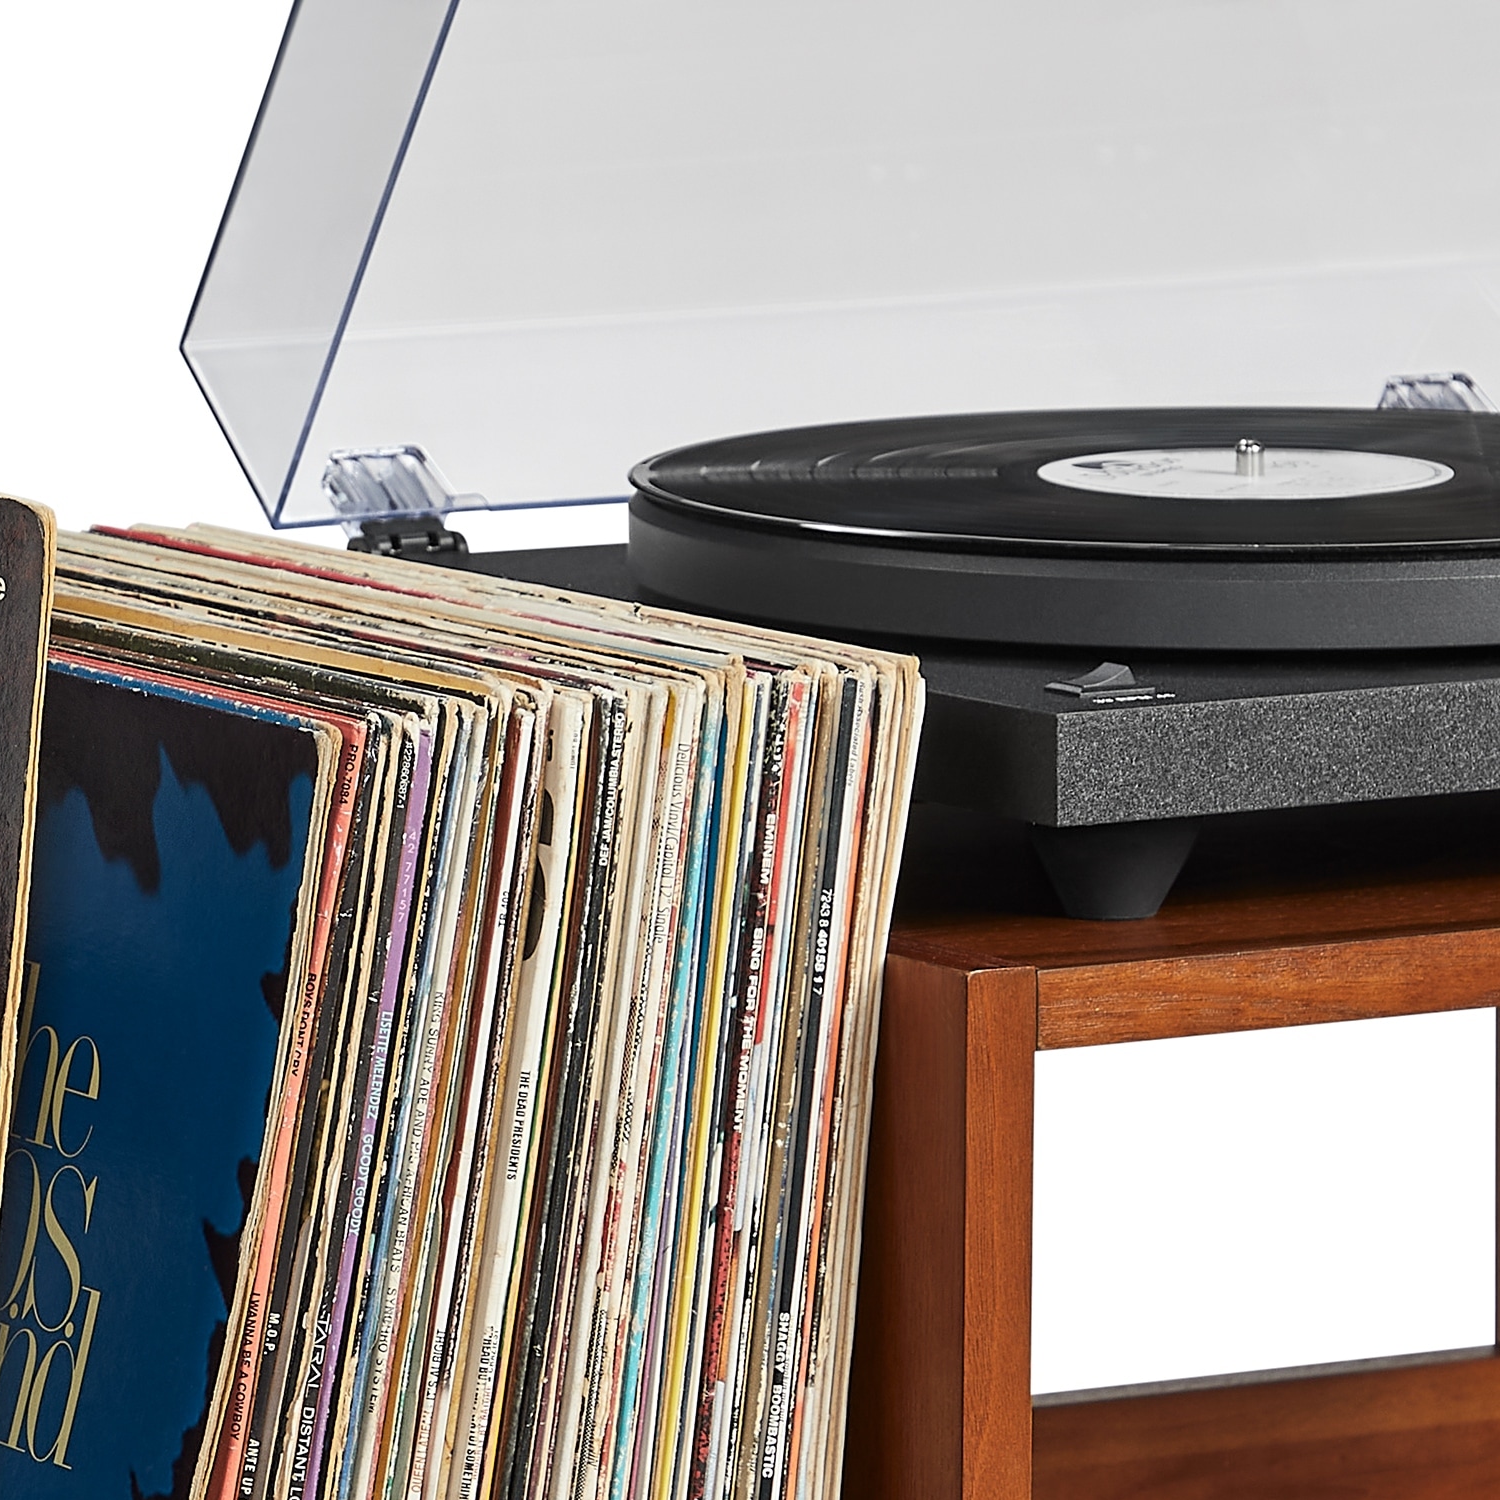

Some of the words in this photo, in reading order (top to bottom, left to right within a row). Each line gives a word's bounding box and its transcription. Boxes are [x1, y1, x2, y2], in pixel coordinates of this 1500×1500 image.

[598, 843, 609, 867] DEF
[611, 713, 624, 757] STEREO
[672, 743, 689, 797] Delicious
[662, 802, 681, 878] Vinyl/Capitol
[759, 813, 778, 884] EMINEM
[819, 887, 832, 916] 7243
[654, 906, 669, 944] Single
[749, 928, 762, 970] SING
[745, 974, 757, 1011] FOR
[376, 1011, 392, 1052] LISETTE
[423, 1028, 439, 1071] SUNNY
[741, 1016, 753, 1049] THE
[367, 1056, 384, 1118] MELENDEZ
[416, 1077, 431, 1104] ADE
[519, 1070, 530, 1089] THE
[734, 1056, 748, 1131] MOMENT
[413, 1109, 424, 1137] AND
[515, 1091, 528, 1117] DEAD
[357, 1134, 373, 1181] GOODY
[509, 1119, 523, 1179] PRESIDENTS
[349, 1186, 365, 1234] GOODY
[244, 1299, 258, 1346] WANNA
[263, 1312, 280, 1355] M.O.P.
[773, 1312, 789, 1371] SHAGGY
[238, 1370, 248, 1380] A
[229, 1383, 246, 1439] COWBOY
[760, 1384, 782, 1477] BOOMBASTIC
[243, 1437, 259, 1473] ANTE
[294, 1407, 313, 1480] DISTANT
[239, 1476, 253, 1495] UP
[410, 1456, 425, 1493] QUEEN
